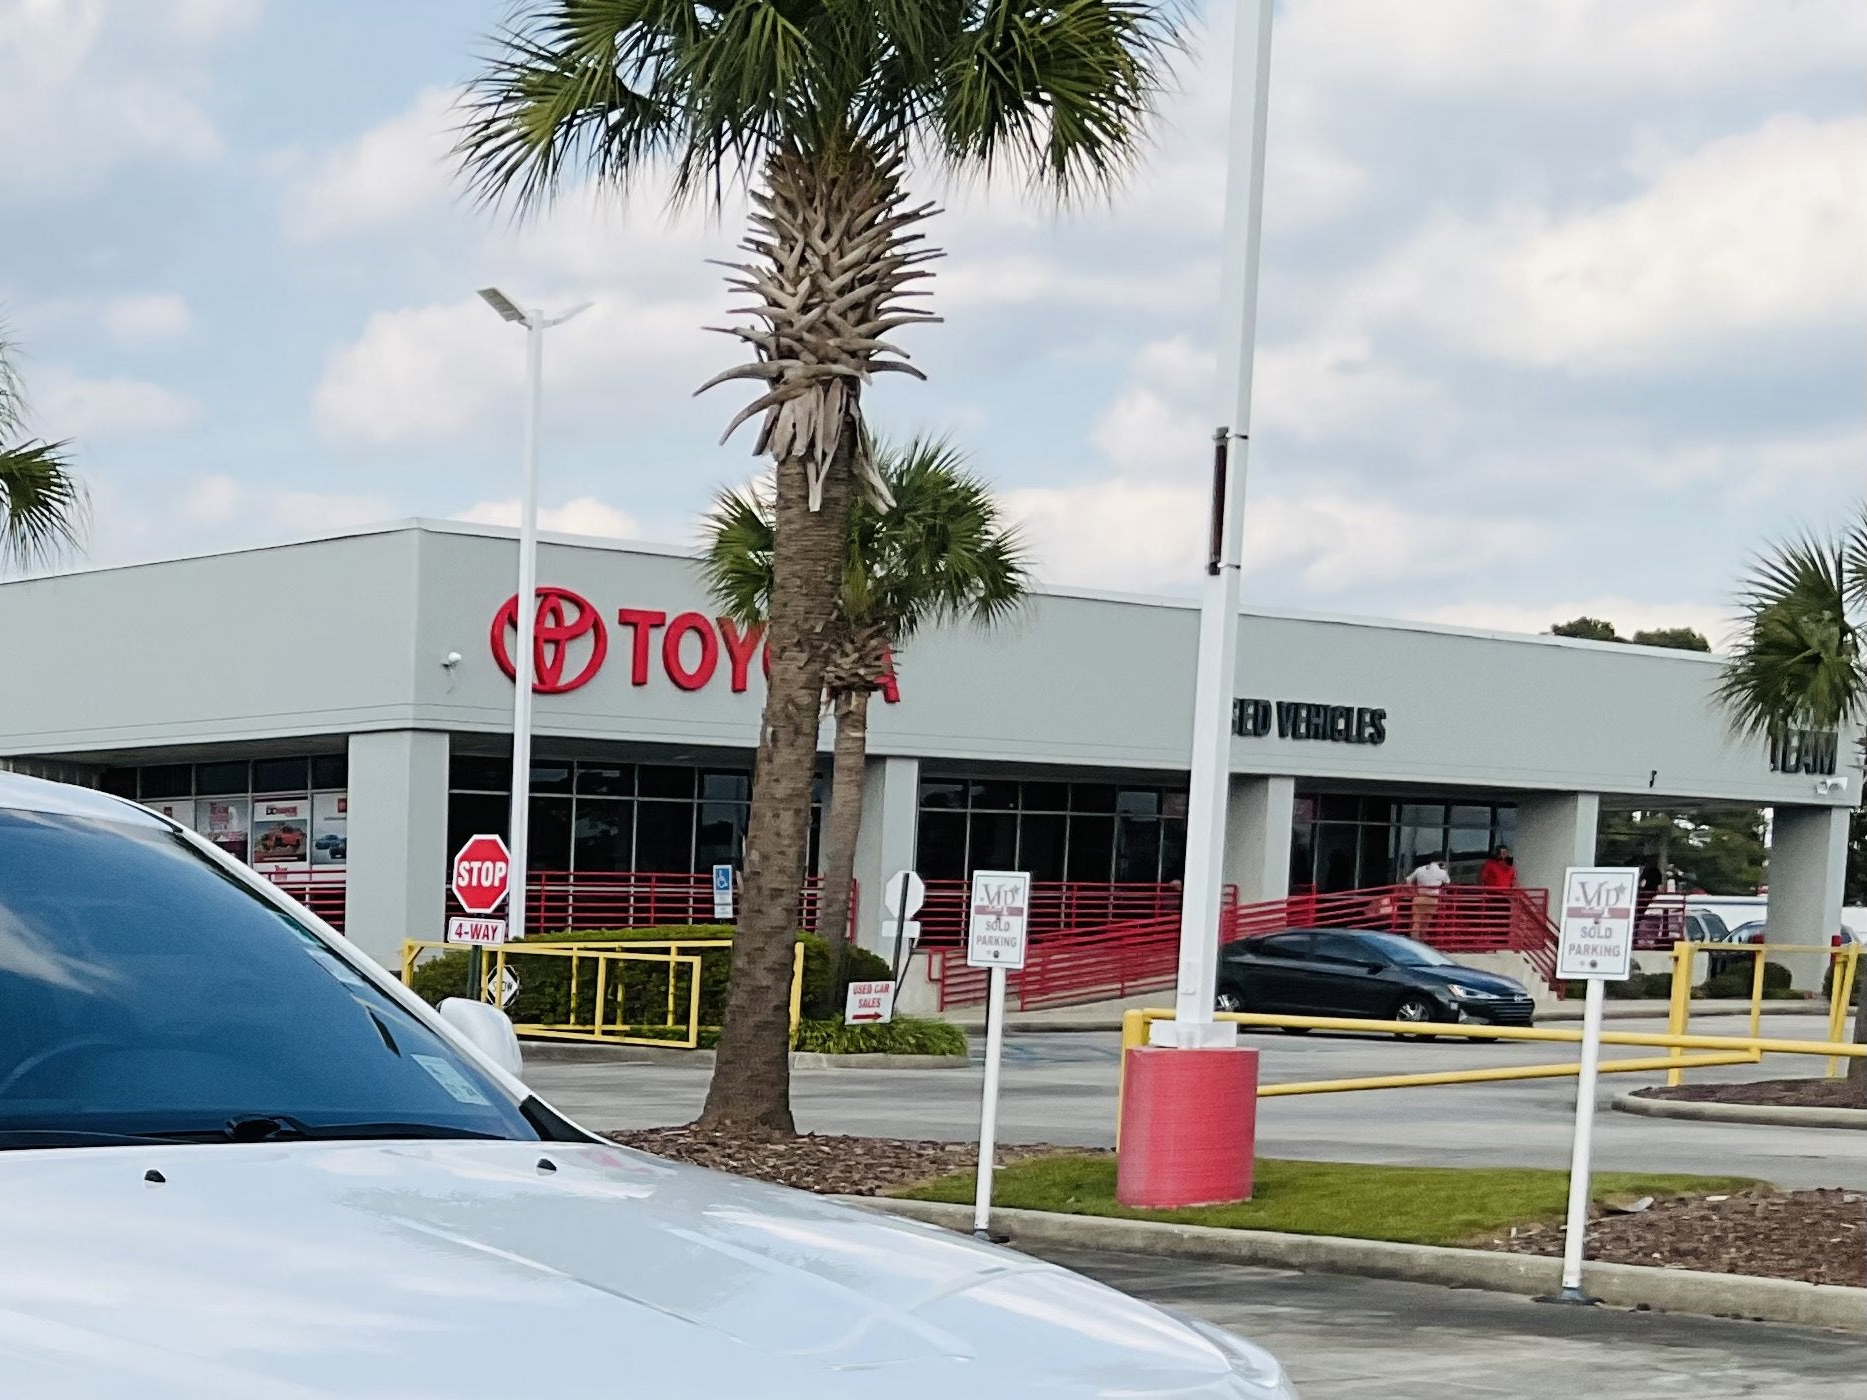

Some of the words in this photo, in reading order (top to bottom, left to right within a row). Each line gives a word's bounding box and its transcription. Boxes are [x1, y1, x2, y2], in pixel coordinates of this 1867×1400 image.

[618, 607, 901, 704] TOY
[1232, 698, 1272, 738] ED
[1276, 700, 1386, 744] VEHICLES
[457, 860, 507, 888] STOP
[454, 922, 498, 941] 4-WAY
[985, 920, 1010, 931] SOLD
[1580, 926, 1612, 939] SOLD
[976, 934, 1017, 947] PARKING
[1568, 942, 1621, 957] PARKING
[492, 980, 513, 991] SOW
[853, 984, 872, 994] USED
[875, 983, 890, 993] CAR
[858, 998, 881, 1008] SALES
